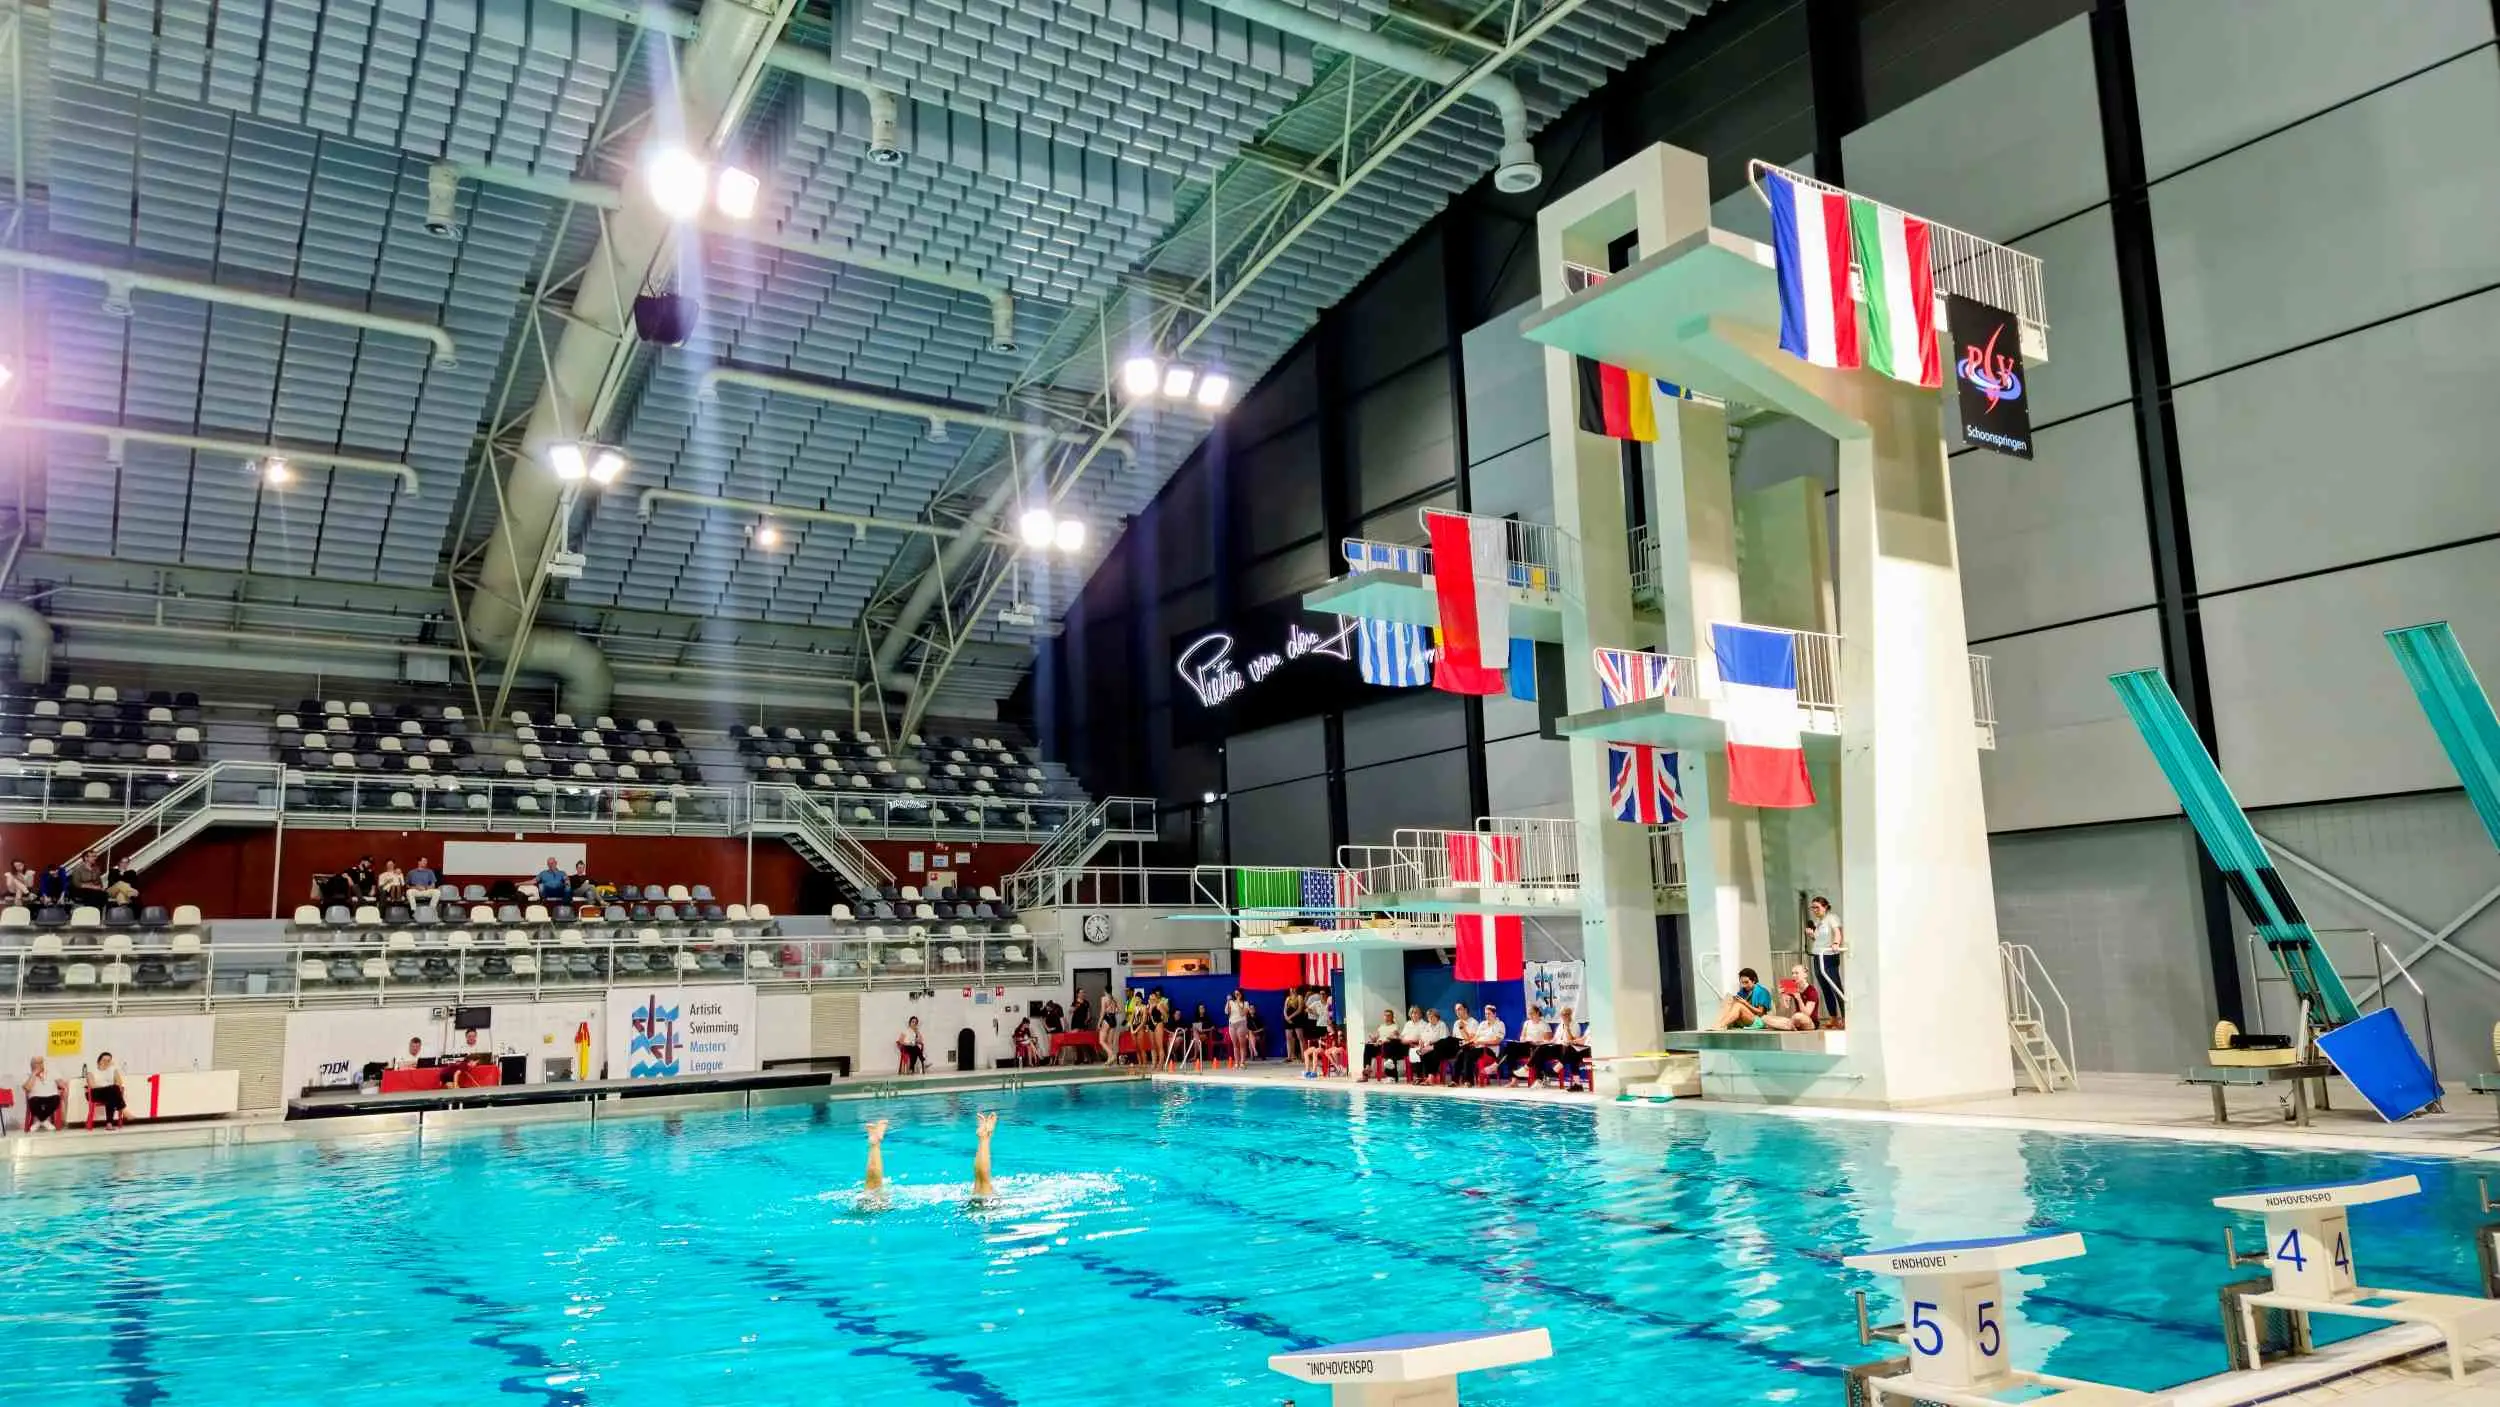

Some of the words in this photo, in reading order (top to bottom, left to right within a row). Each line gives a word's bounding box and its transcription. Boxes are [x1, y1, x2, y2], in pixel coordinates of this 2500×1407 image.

[1967, 424, 2027, 450] Schoonspringen
[1178, 633, 1244, 707] Pieter
[1248, 653, 1283, 682] van
[689, 1003, 722, 1016] Artistic
[689, 1021, 739, 1035] Swimming
[689, 1041, 726, 1053] Masters
[690, 1060, 723, 1074] League
[147, 1074, 160, 1118] 1
[2277, 1228, 2307, 1272] 4
[2335, 1231, 2349, 1275] 4
[1913, 1301, 1944, 1356] 5
[1978, 1301, 2000, 1356] 5
